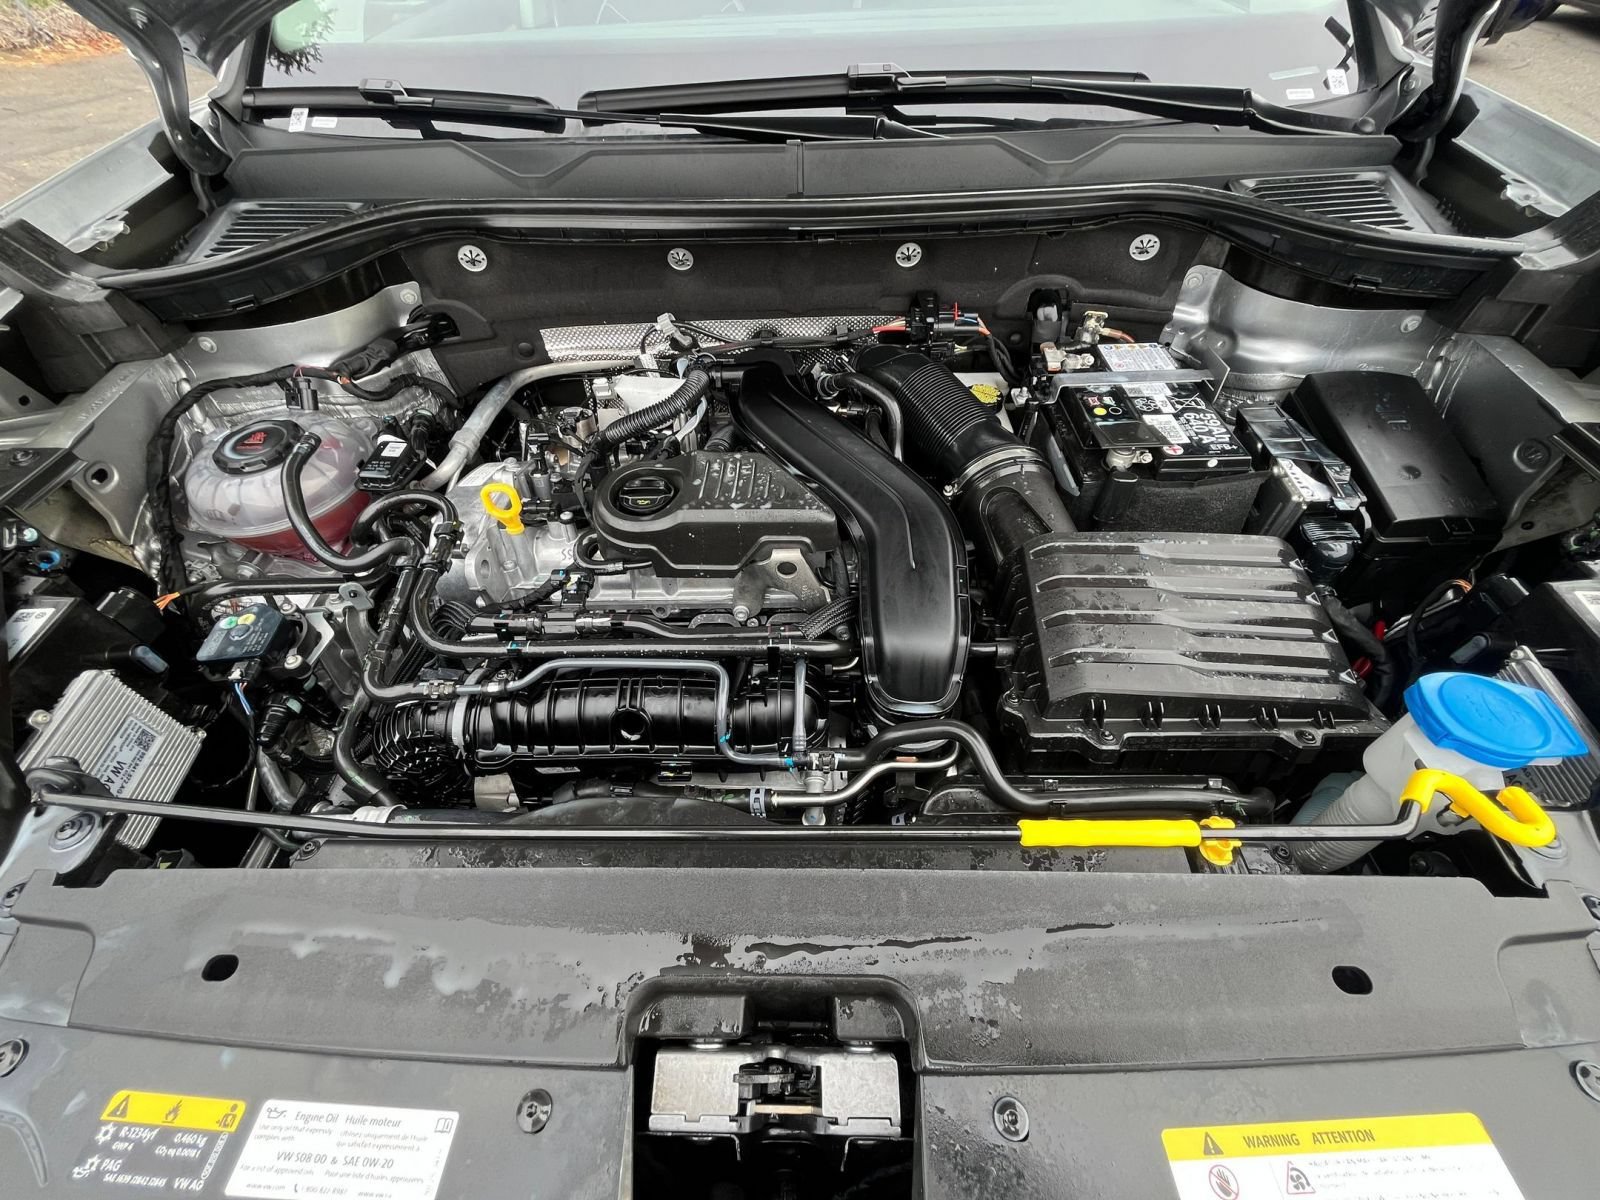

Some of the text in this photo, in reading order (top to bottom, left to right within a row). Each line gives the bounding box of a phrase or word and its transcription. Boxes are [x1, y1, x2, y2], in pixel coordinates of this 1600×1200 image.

[1183, 412, 1209, 433] 640
[1198, 434, 1217, 444] A
[110, 760, 127, 778] VW
[295, 1111, 339, 1124] Engine Oil
[345, 1114, 402, 1127] Huile moteur
[120, 1127, 159, 1143] R-1234yf
[1243, 1128, 1376, 1149] WARNING ATTENTION
[100, 1159, 122, 1171] PAG
[277, 1151, 294, 1161] VW
[313, 1153, 328, 1164] 00
[330, 1156, 338, 1165] &
[342, 1155, 361, 1167] SAE
[173, 1177, 204, 1191] VW AG
